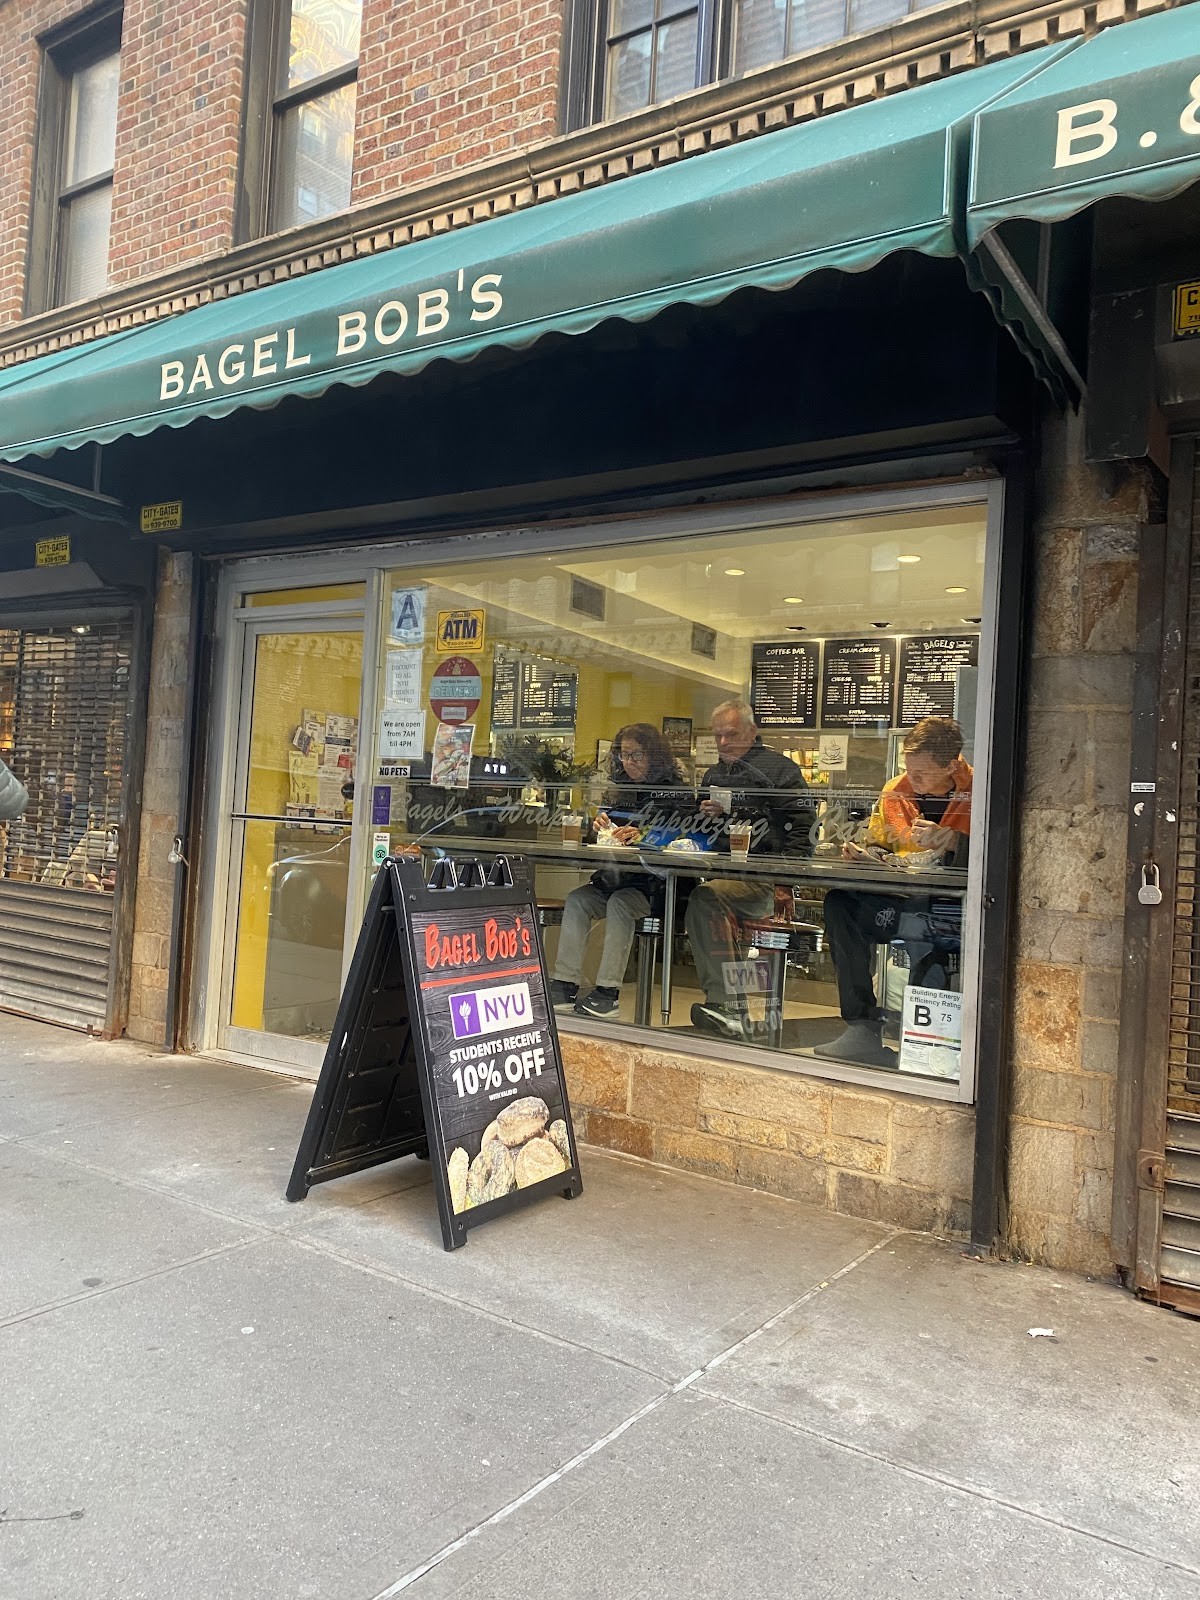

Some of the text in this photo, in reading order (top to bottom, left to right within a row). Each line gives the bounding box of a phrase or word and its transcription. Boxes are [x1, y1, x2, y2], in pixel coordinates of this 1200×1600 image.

[1053, 98, 1157, 169] B.
[159, 268, 503, 401] BAGEL BOB'S
[143, 504, 179, 519] CITY-GATES
[150, 519, 178, 529] 939-9700
[38, 542, 67, 554] CITY-GATES
[396, 594, 419, 629] A
[442, 619, 477, 641] ATM
[792, 647, 806, 655] BAR
[923, 639, 956, 651] BAGELS
[384, 720, 394, 728] We
[405, 721, 421, 729] open
[379, 767, 408, 776] NO PETS
[484, 763, 507, 774] ATM
[495, 795, 579, 834] Wraps
[624, 799, 770, 848] Appetizing
[808, 806, 955, 858] Catering
[425, 917, 531, 969] BAGEL BOB'S
[911, 988, 961, 1002] Building Energy
[483, 993, 526, 1023] NYU
[909, 996, 961, 1011] Efficiency Rating
[914, 1005, 932, 1026] B
[941, 1013, 952, 1023] 75
[449, 1030, 542, 1064] STUDENTS RECEIVE
[451, 1047, 546, 1098] 10% OFF
